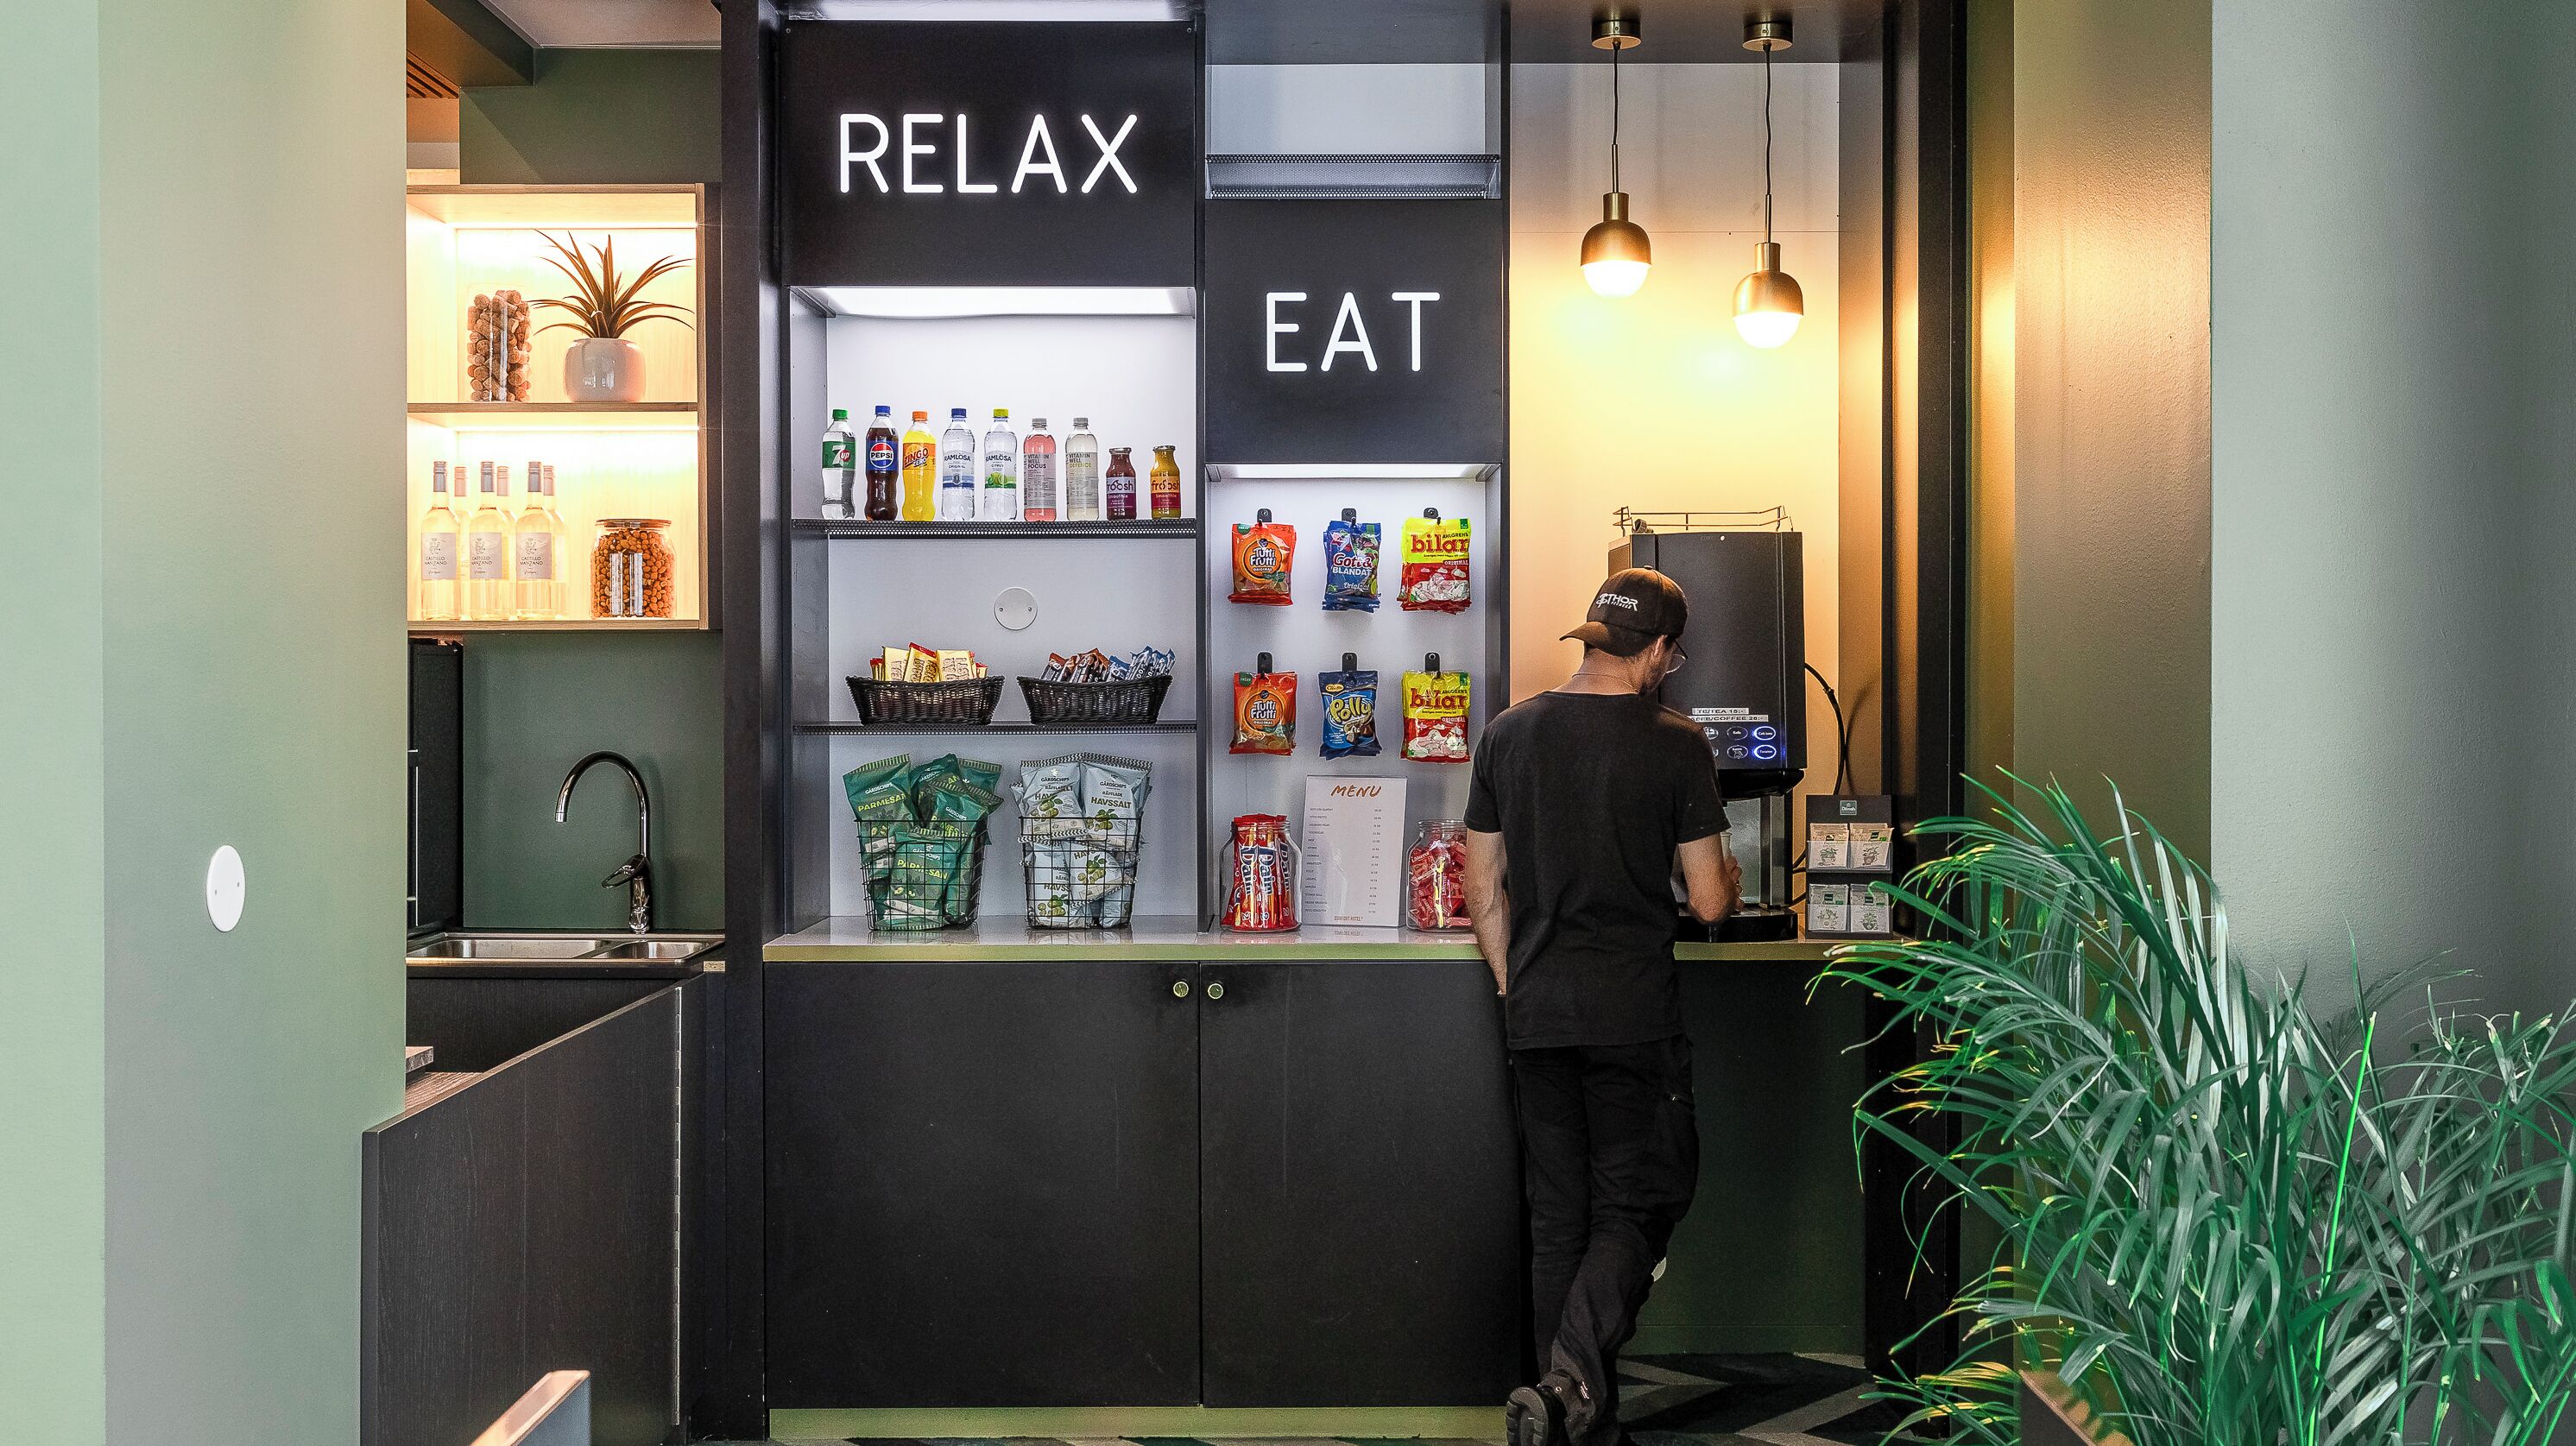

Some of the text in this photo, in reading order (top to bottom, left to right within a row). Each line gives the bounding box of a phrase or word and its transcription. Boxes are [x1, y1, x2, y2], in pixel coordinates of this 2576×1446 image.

[839, 114, 1138, 194] RELAX
[1266, 292, 1441, 373] EAT
[904, 447, 929, 466] ZINGO
[944, 453, 971, 462] RAMLÖSA
[985, 453, 1012, 462] RAMLÖSA
[1411, 534, 1469, 553] bilar
[1253, 546, 1276, 558] Tutti
[1250, 554, 1276, 566] Frutti
[1332, 566, 1373, 576] BLANDAT
[1343, 582, 1370, 591] Original
[1607, 593, 1638, 611] THOR
[1253, 700, 1276, 710] Tutti
[1410, 687, 1468, 710] bilar
[1250, 708, 1277, 719] Frutti
[1330, 697, 1372, 724] Polly
[865, 782, 893, 794] GÅRDSCHIPS
[1100, 780, 1127, 789] GÅRDSCHIPS
[1330, 784, 1381, 798] MENU
[857, 792, 906, 812] PARMESAN
[1090, 796, 1132, 809] HAVSSALT
[1239, 843, 1258, 895] Daim
[1258, 844, 1277, 896] Daim
[1279, 837, 1291, 891] Daim
[1044, 883, 1070, 893] HAVSS
